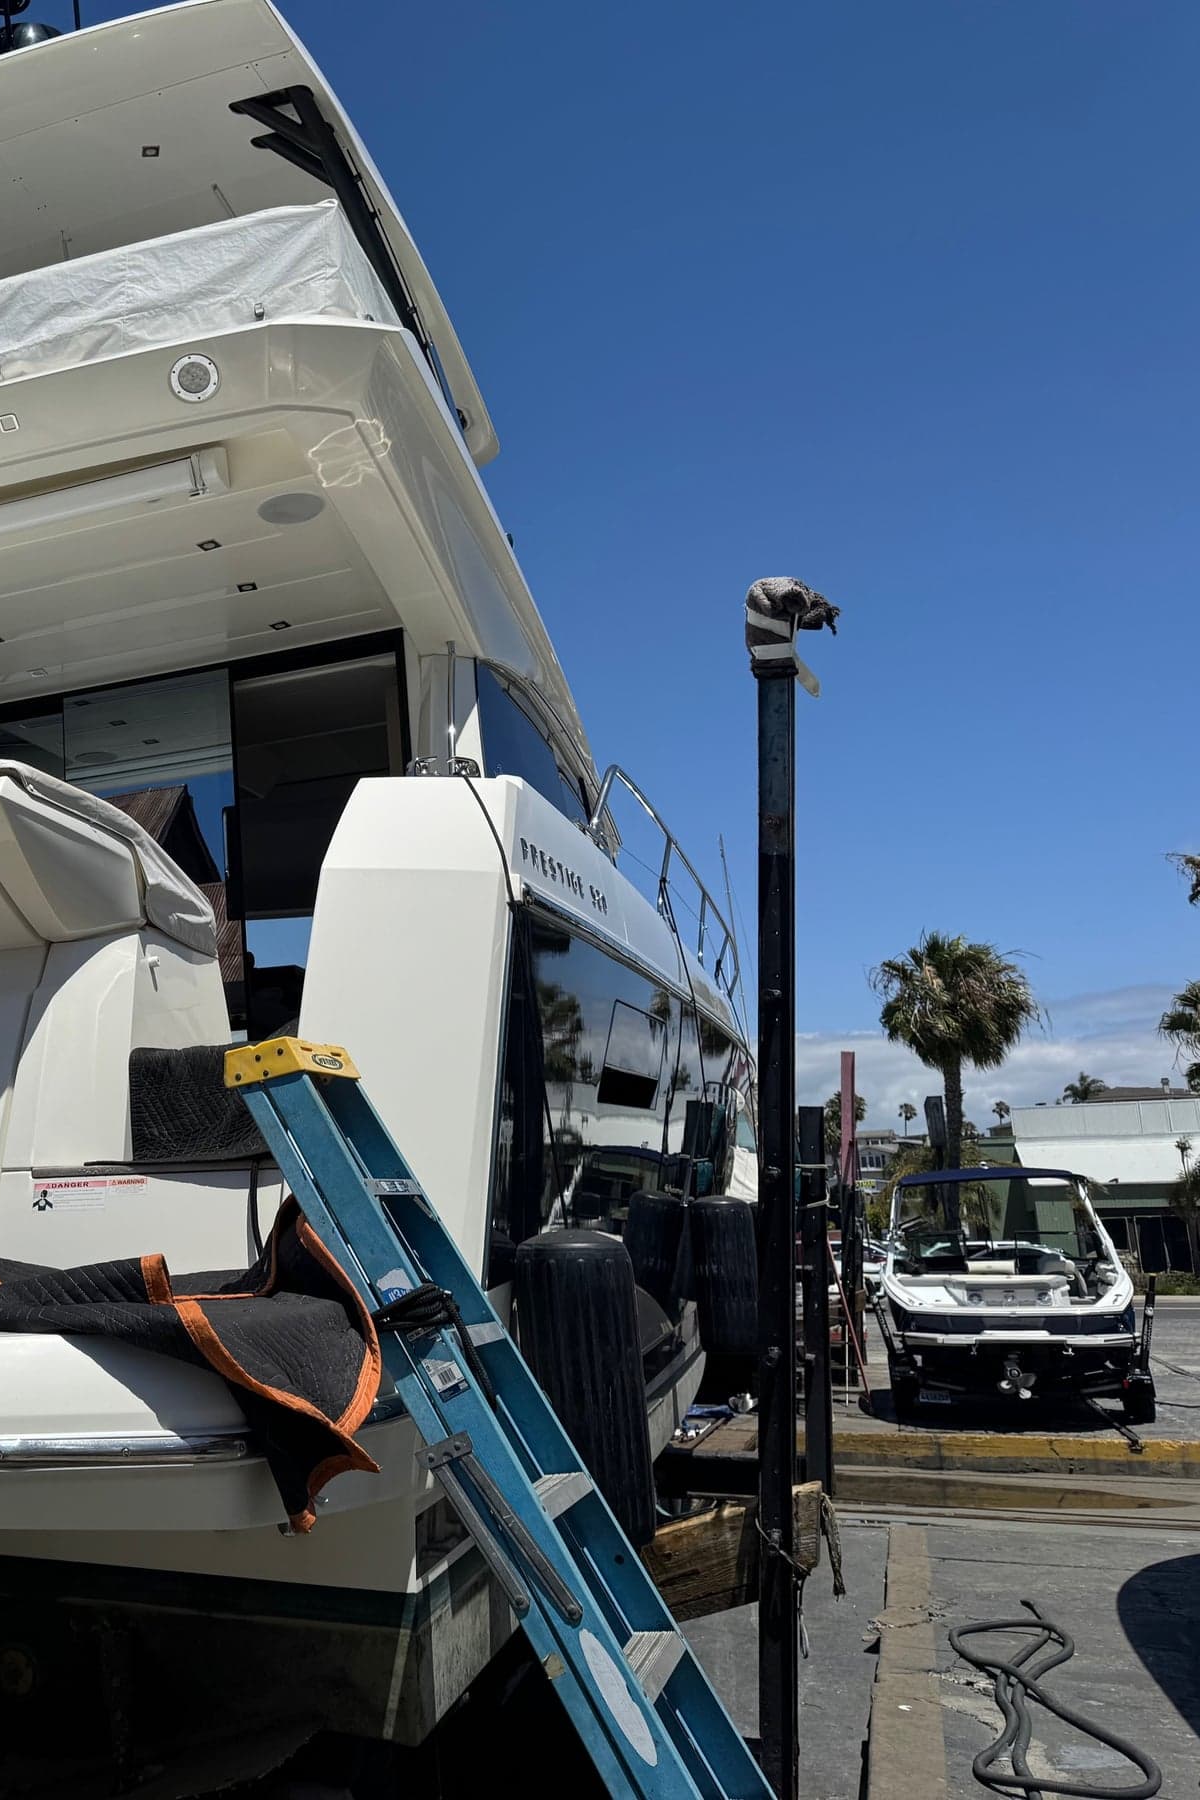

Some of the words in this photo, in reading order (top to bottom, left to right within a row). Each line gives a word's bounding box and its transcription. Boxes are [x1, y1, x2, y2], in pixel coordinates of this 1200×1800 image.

[520, 837, 585, 900] PRESTIGE
[51, 1181, 90, 1189] DANGER
[116, 1178, 145, 1186] WARNING
